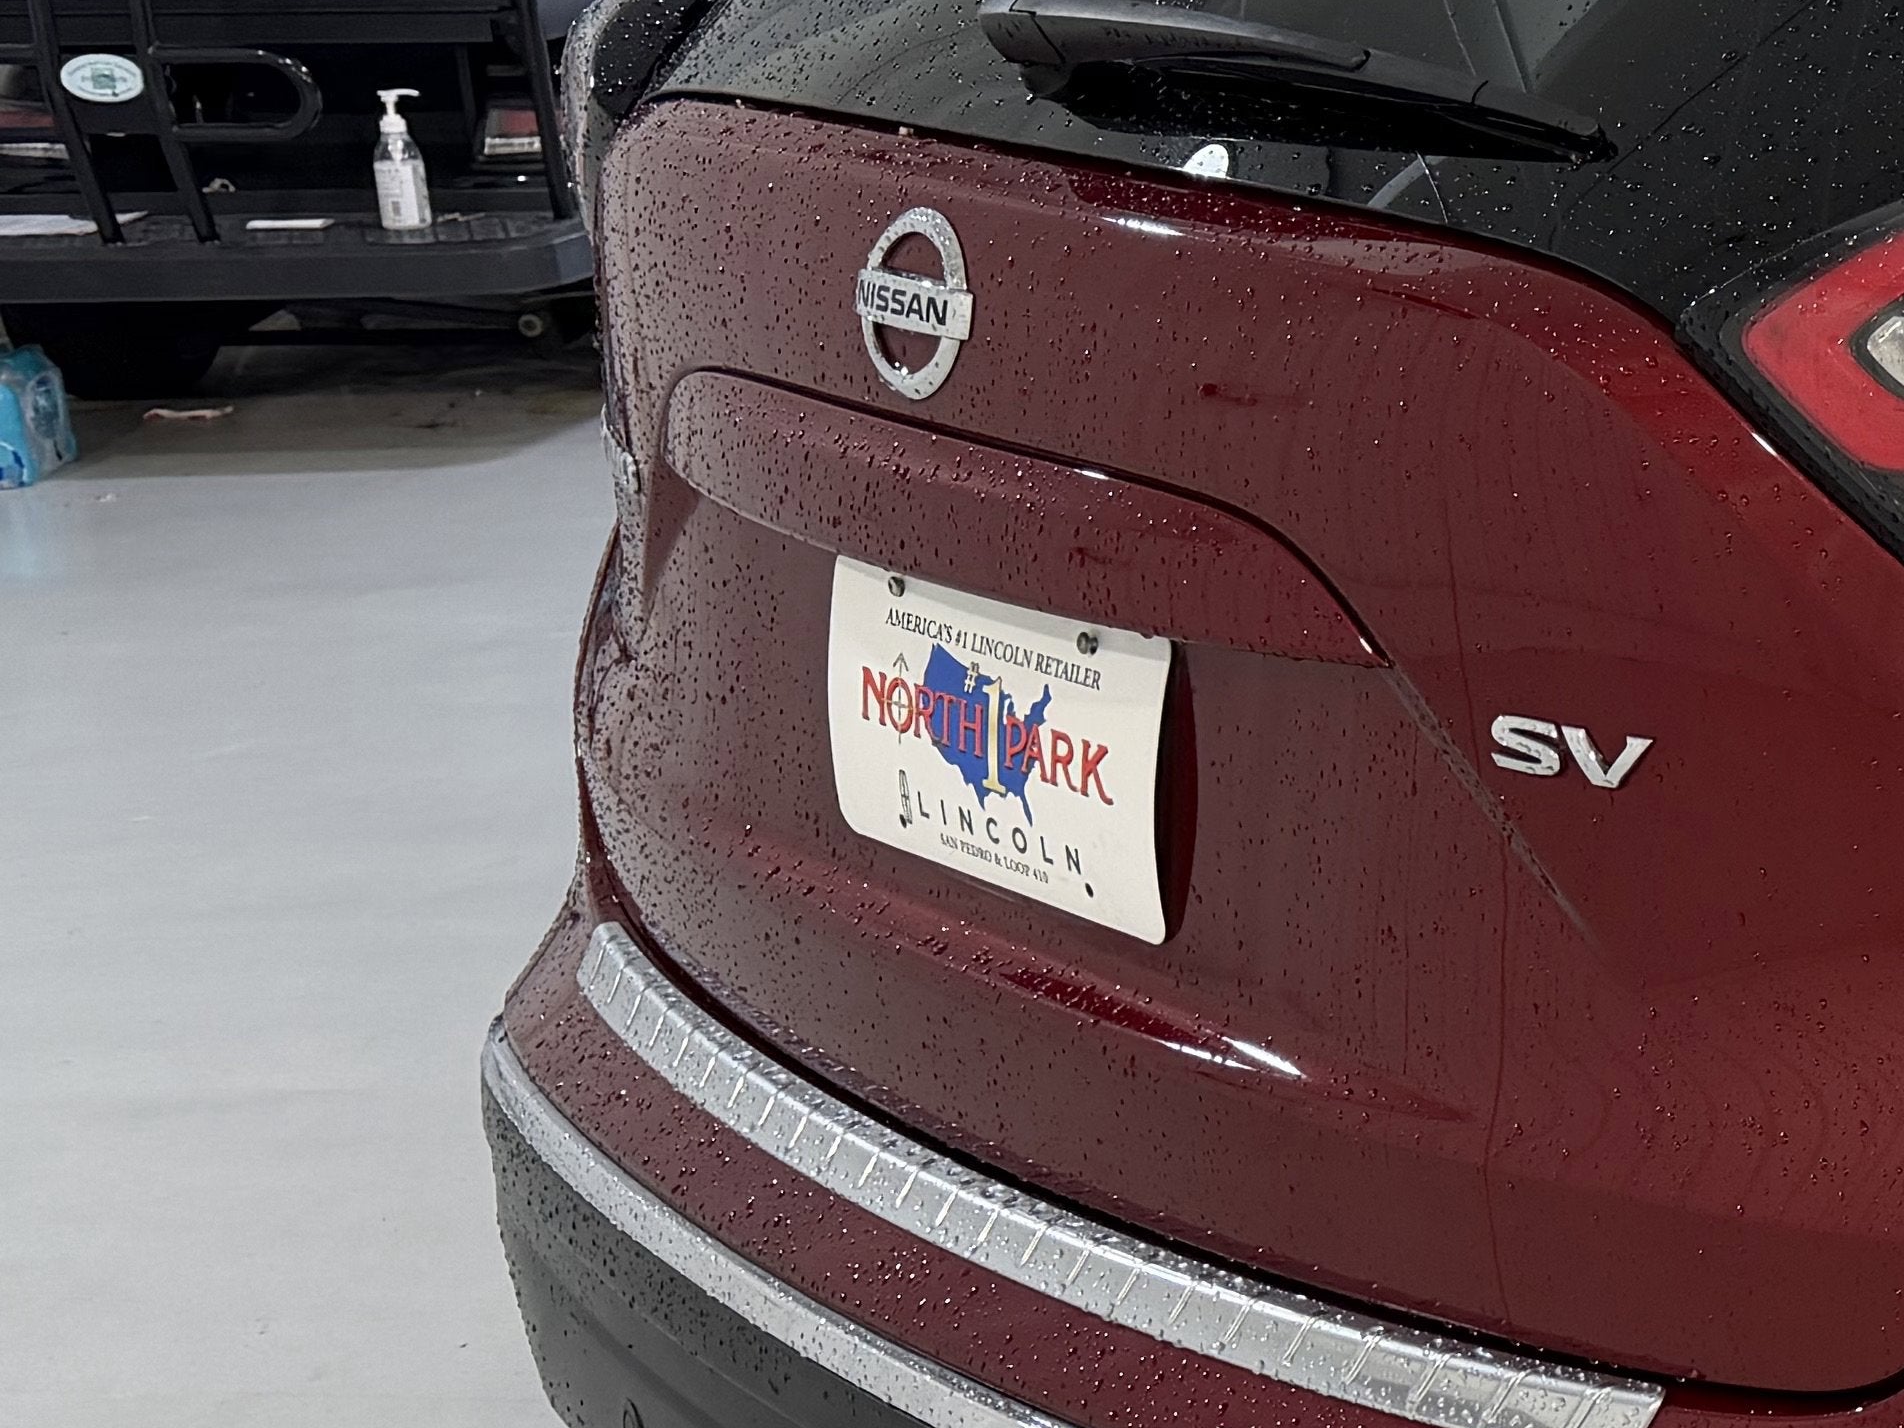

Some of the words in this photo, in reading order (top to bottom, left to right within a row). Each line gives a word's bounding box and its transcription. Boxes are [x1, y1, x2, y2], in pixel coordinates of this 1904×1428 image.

[858, 279, 948, 326] NISSAN
[886, 608, 953, 645] AMERICA'S
[955, 629, 968, 649] #1
[971, 632, 1034, 670] LINCOLN
[1034, 653, 1102, 690] RETAILER
[861, 665, 985, 759] NORTH
[1003, 714, 1114, 806] PARK
[1490, 714, 1654, 789] SV
[917, 790, 1082, 876] LINCOLN
[960, 839, 992, 863] PEDRO
